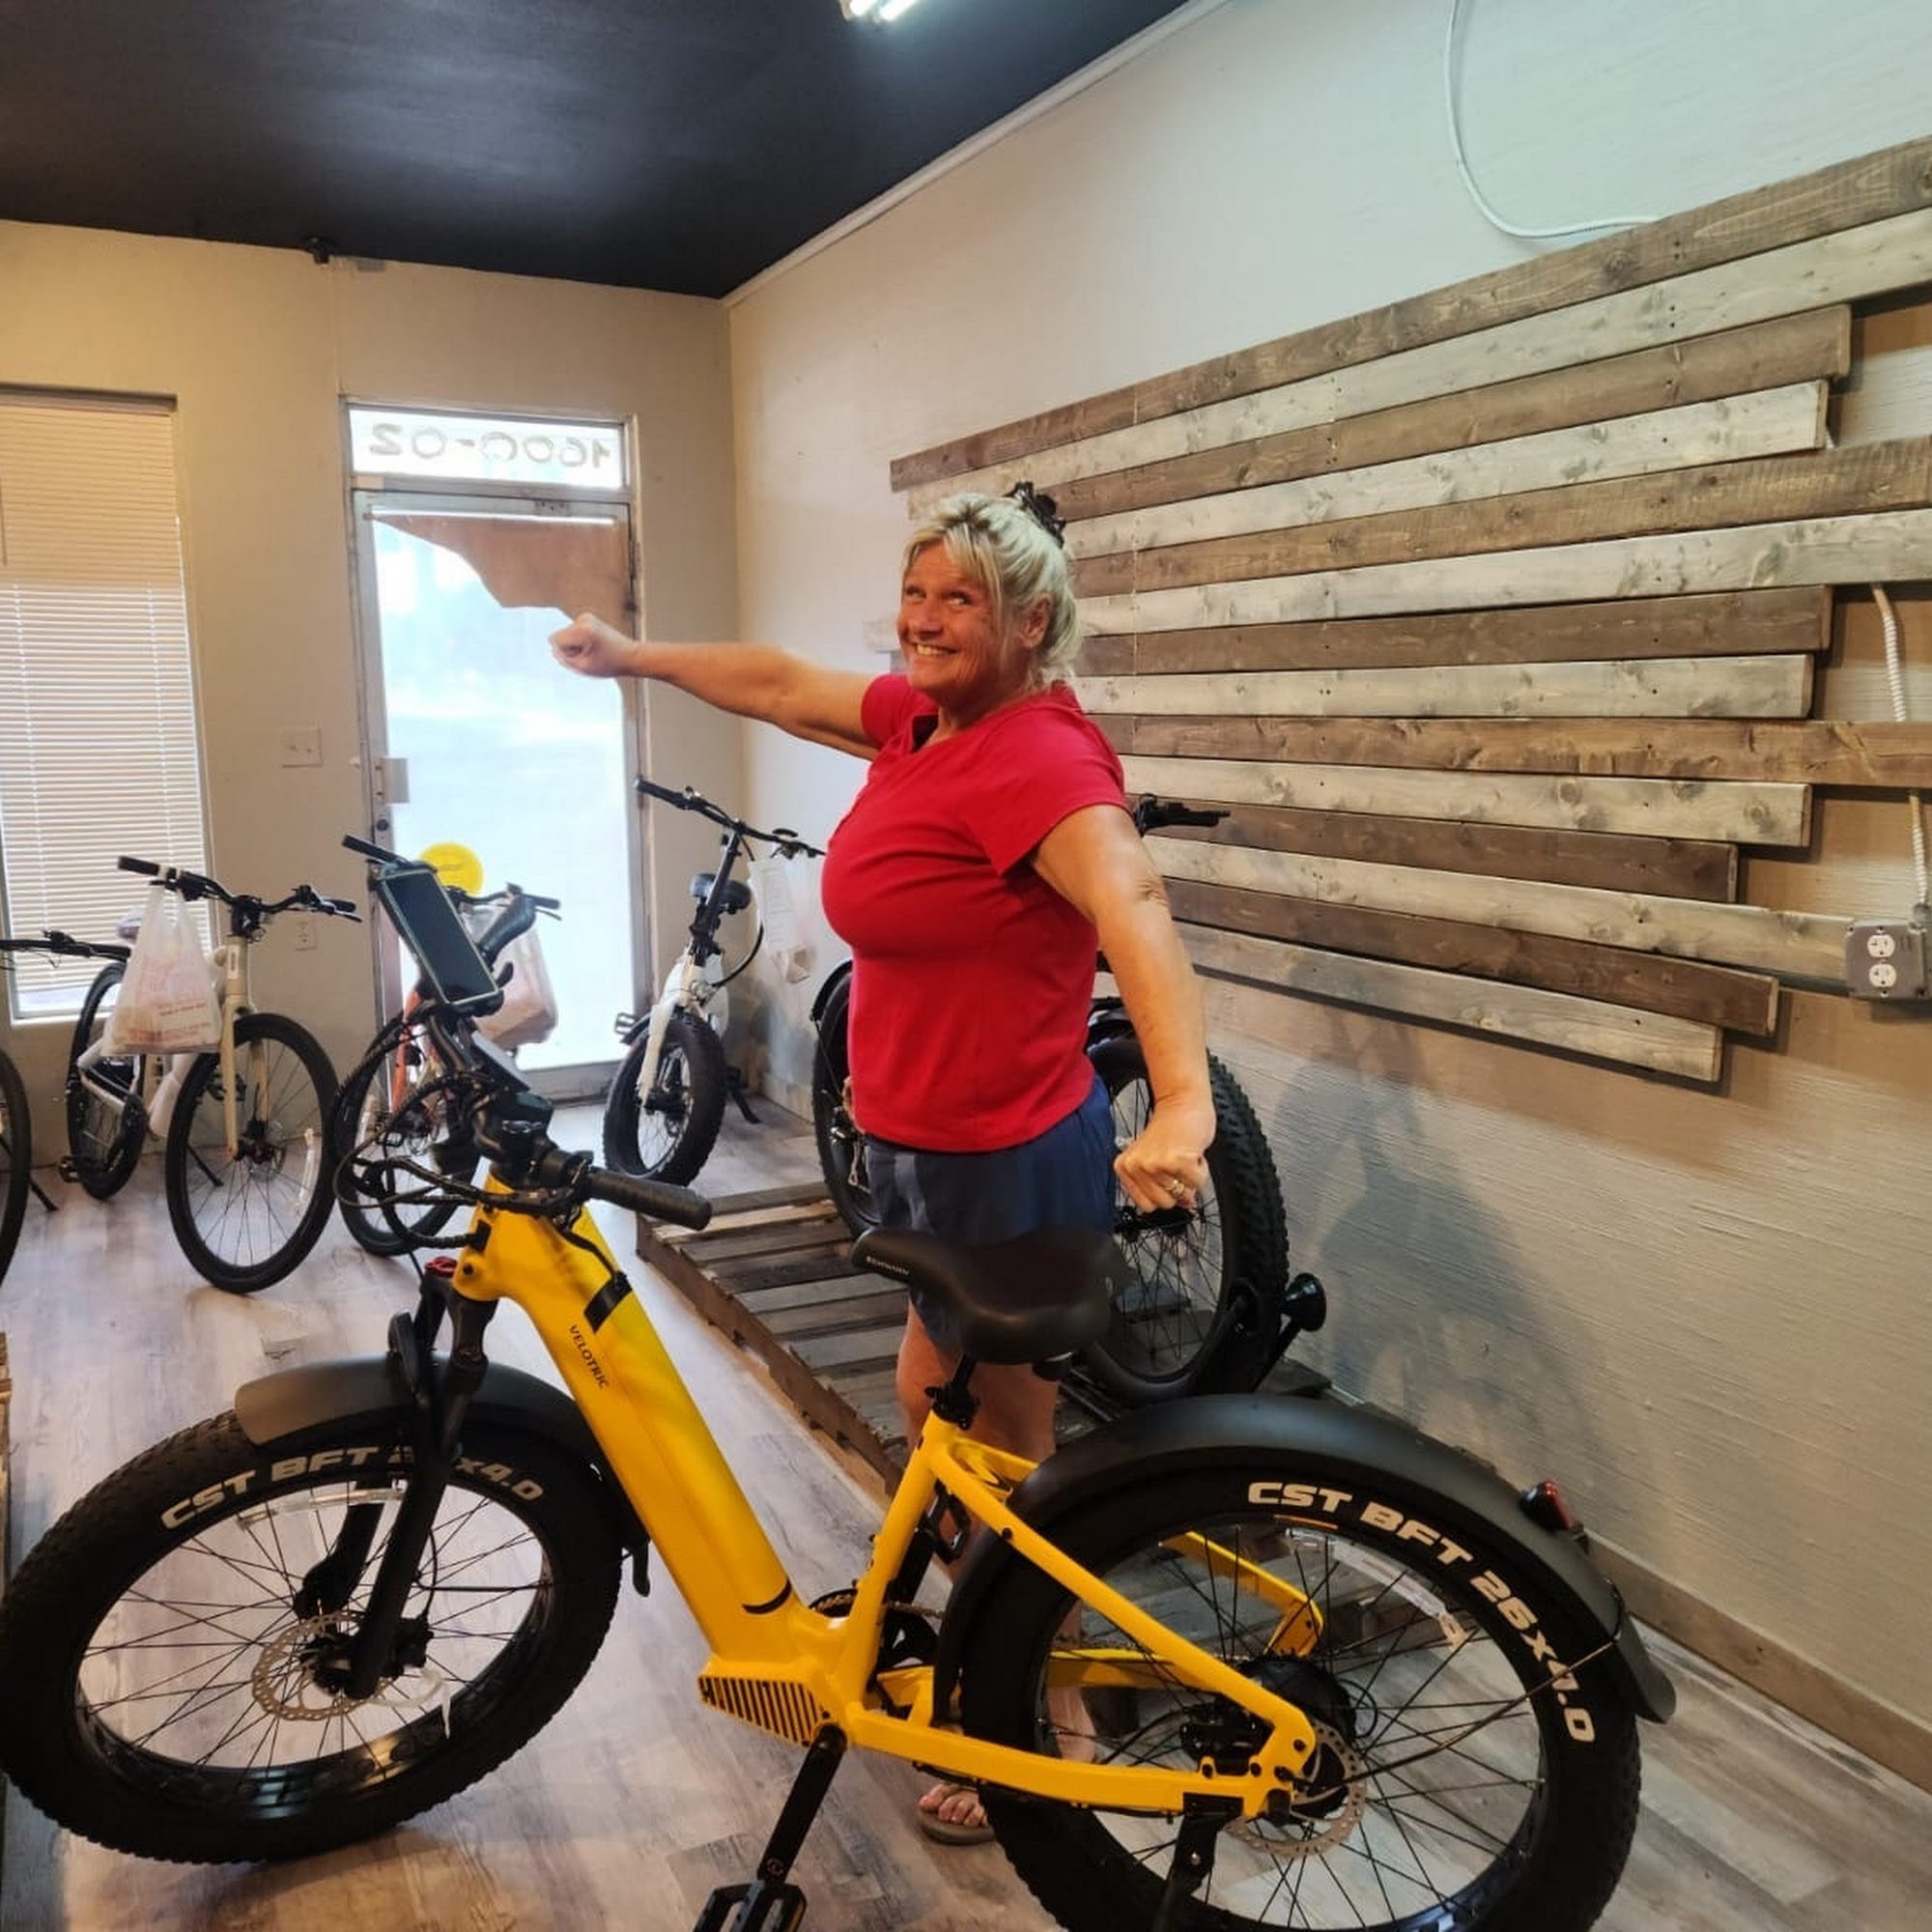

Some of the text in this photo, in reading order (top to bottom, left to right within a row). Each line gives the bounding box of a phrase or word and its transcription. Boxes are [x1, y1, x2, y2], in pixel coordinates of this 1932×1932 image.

[569, 1324, 611, 1388] VELOTRIC
[160, 1444, 544, 1530] CST BFT 2x4.0
[1248, 1482, 1596, 1744] CST BFT 26x4.0
